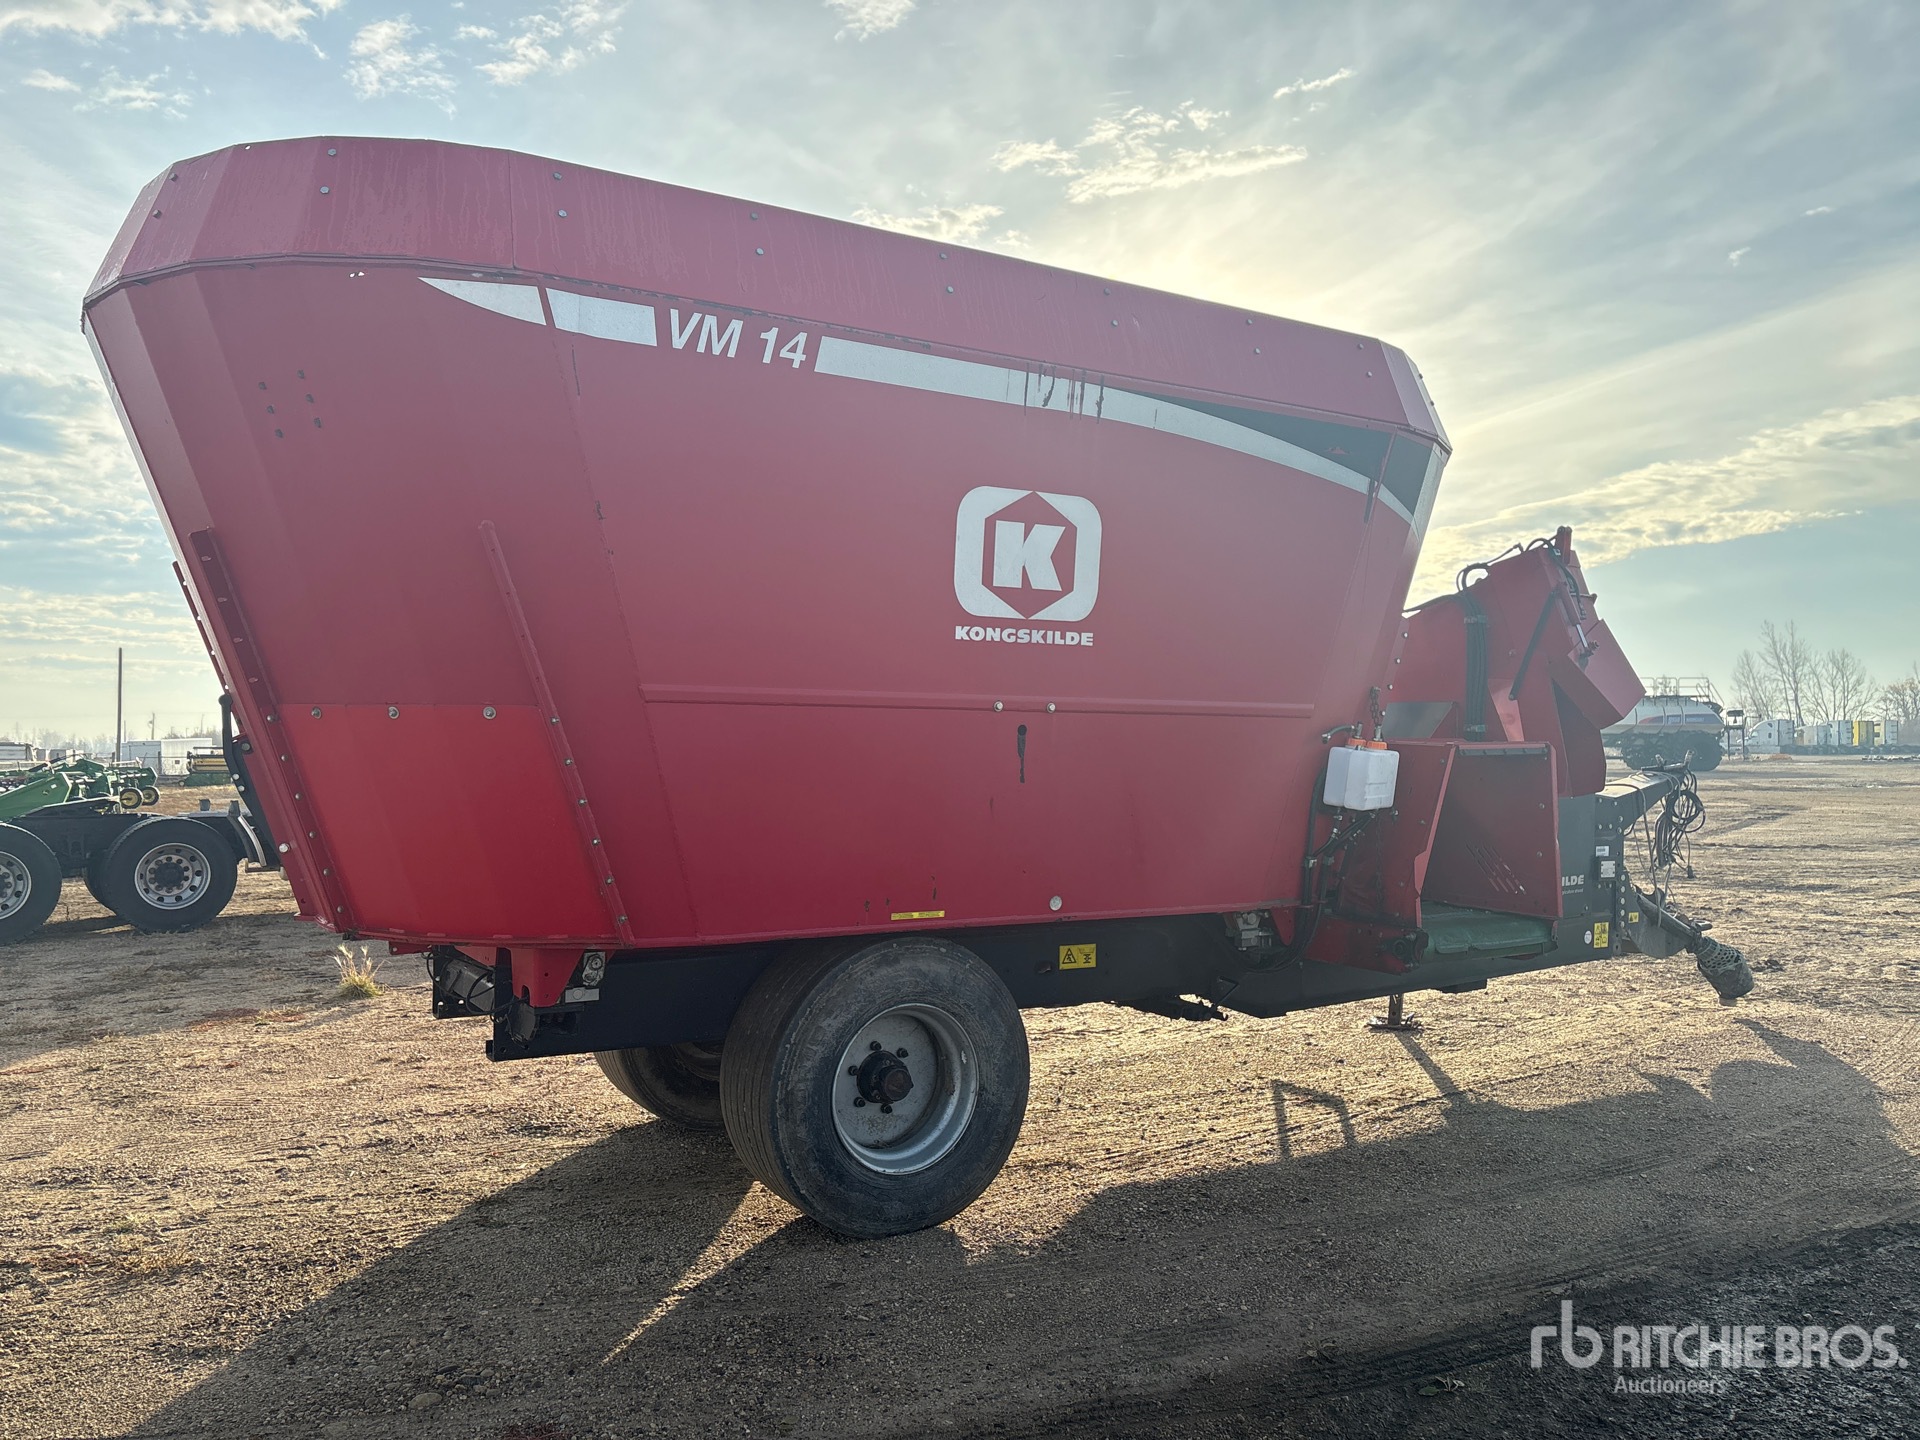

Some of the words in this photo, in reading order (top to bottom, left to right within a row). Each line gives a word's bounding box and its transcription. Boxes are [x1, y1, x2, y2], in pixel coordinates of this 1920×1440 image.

[670, 308, 744, 358] VM
[760, 326, 808, 369] 14
[993, 520, 1066, 591] K
[955, 625, 1094, 646] KONGSKILDE
